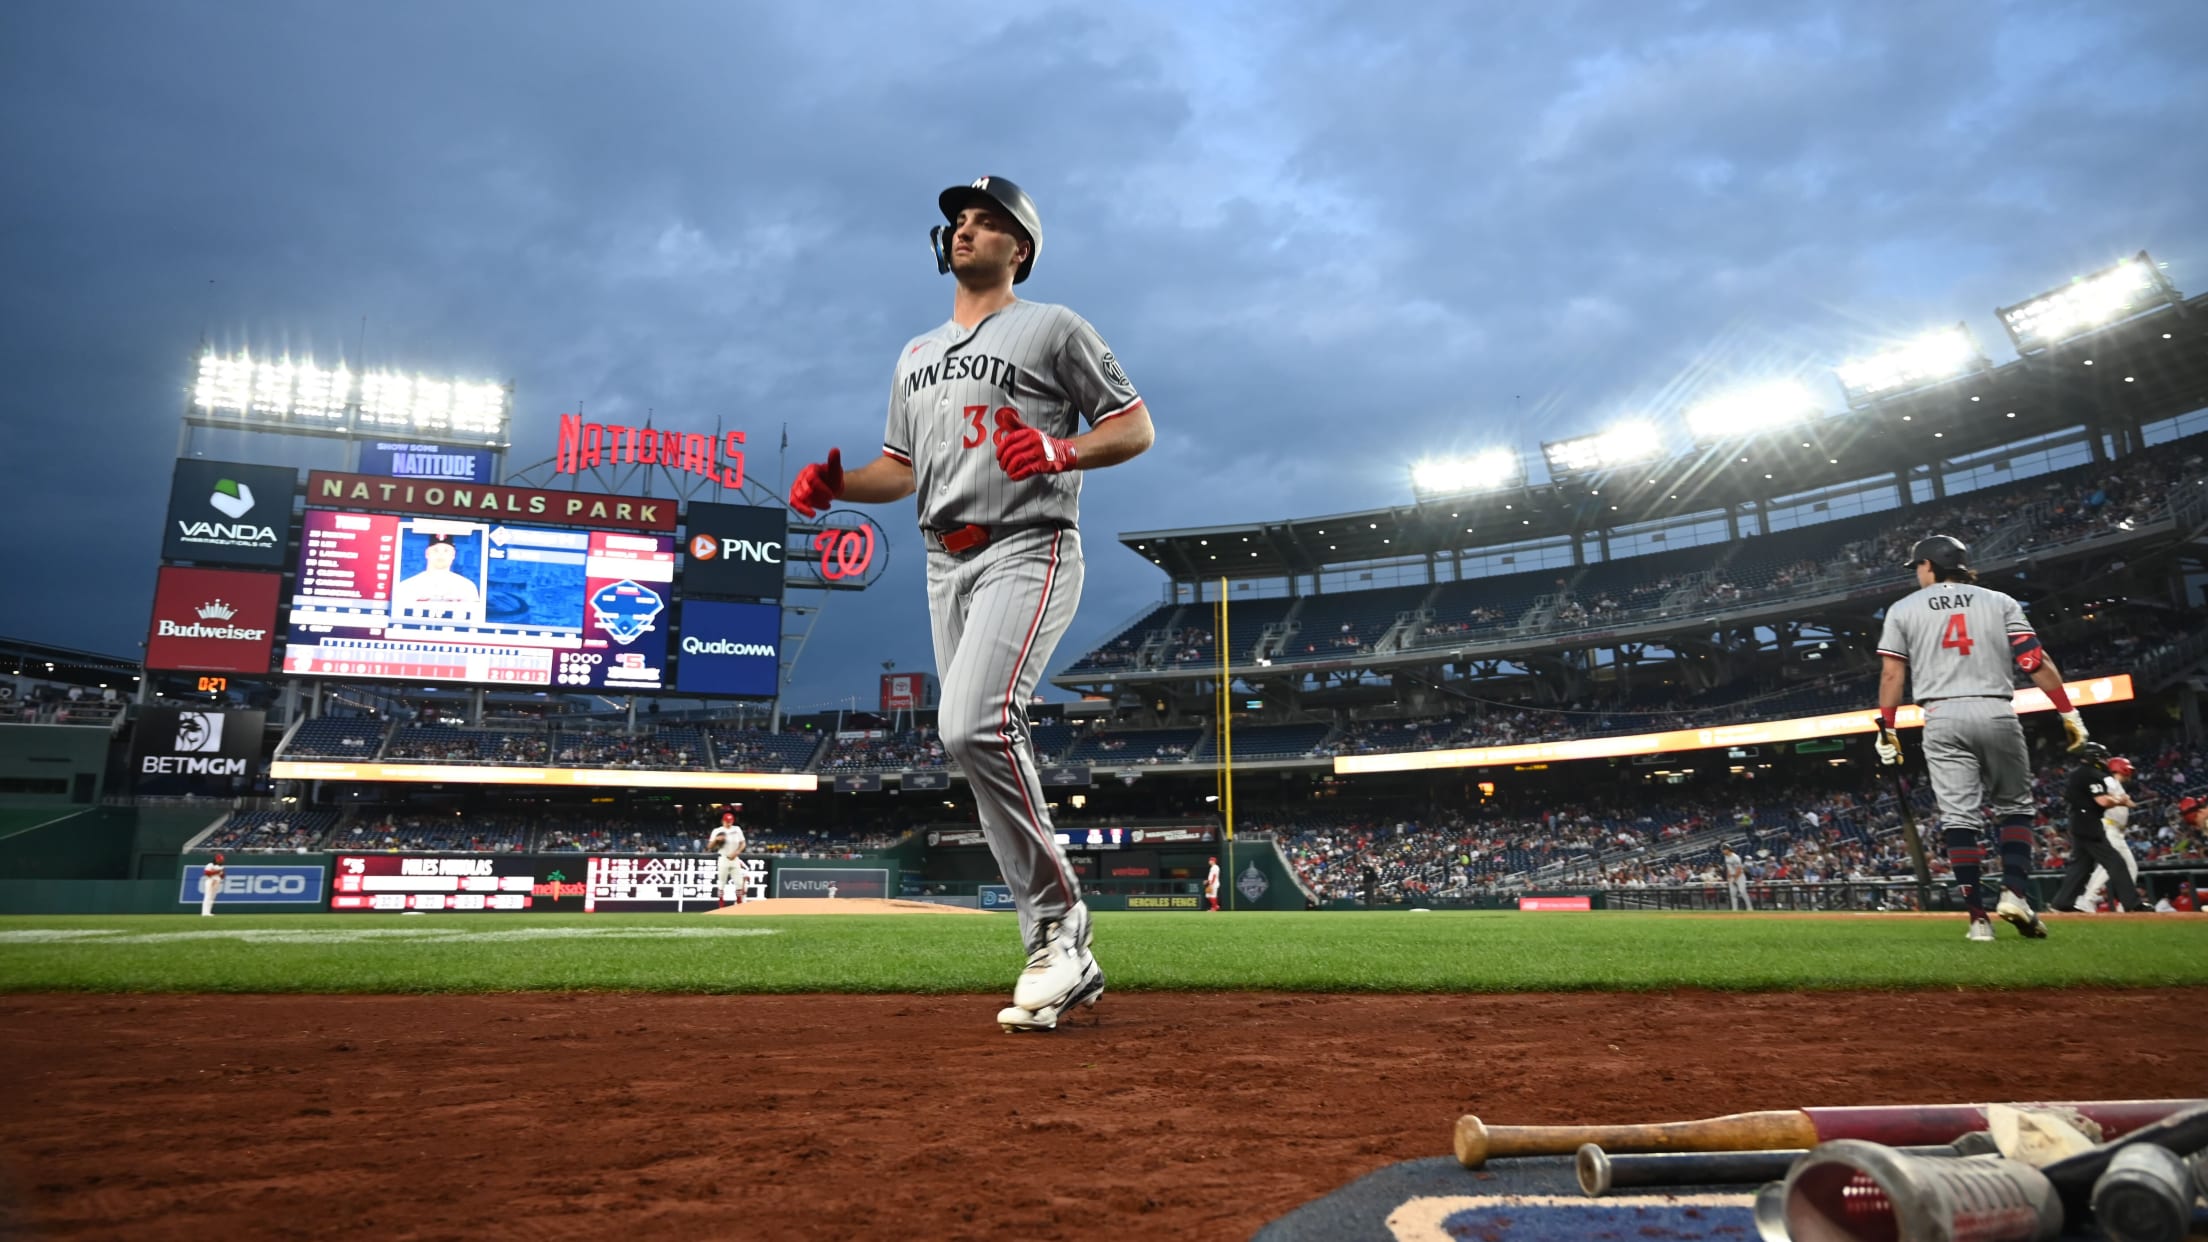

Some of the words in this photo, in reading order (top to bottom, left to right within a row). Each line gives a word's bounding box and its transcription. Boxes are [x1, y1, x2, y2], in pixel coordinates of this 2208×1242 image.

[904, 354, 1016, 400] INNESOTA
[556, 413, 746, 490] NATIONALS
[392, 453, 475, 476] NATITUDE
[322, 479, 546, 514] NATIONALS
[567, 499, 657, 522] PARK
[178, 521, 277, 541] VANDA
[721, 538, 781, 563] PNC
[814, 523, 874, 581] W
[1928, 594, 1974, 611] GRAY
[158, 620, 266, 641] Budweiser
[1942, 613, 1974, 656] 4
[682, 636, 775, 657] Qualcomm
[142, 756, 247, 776] BETMGM
[1128, 897, 1169, 907] HERCULES
[1171, 898, 1197, 907] FENCE
